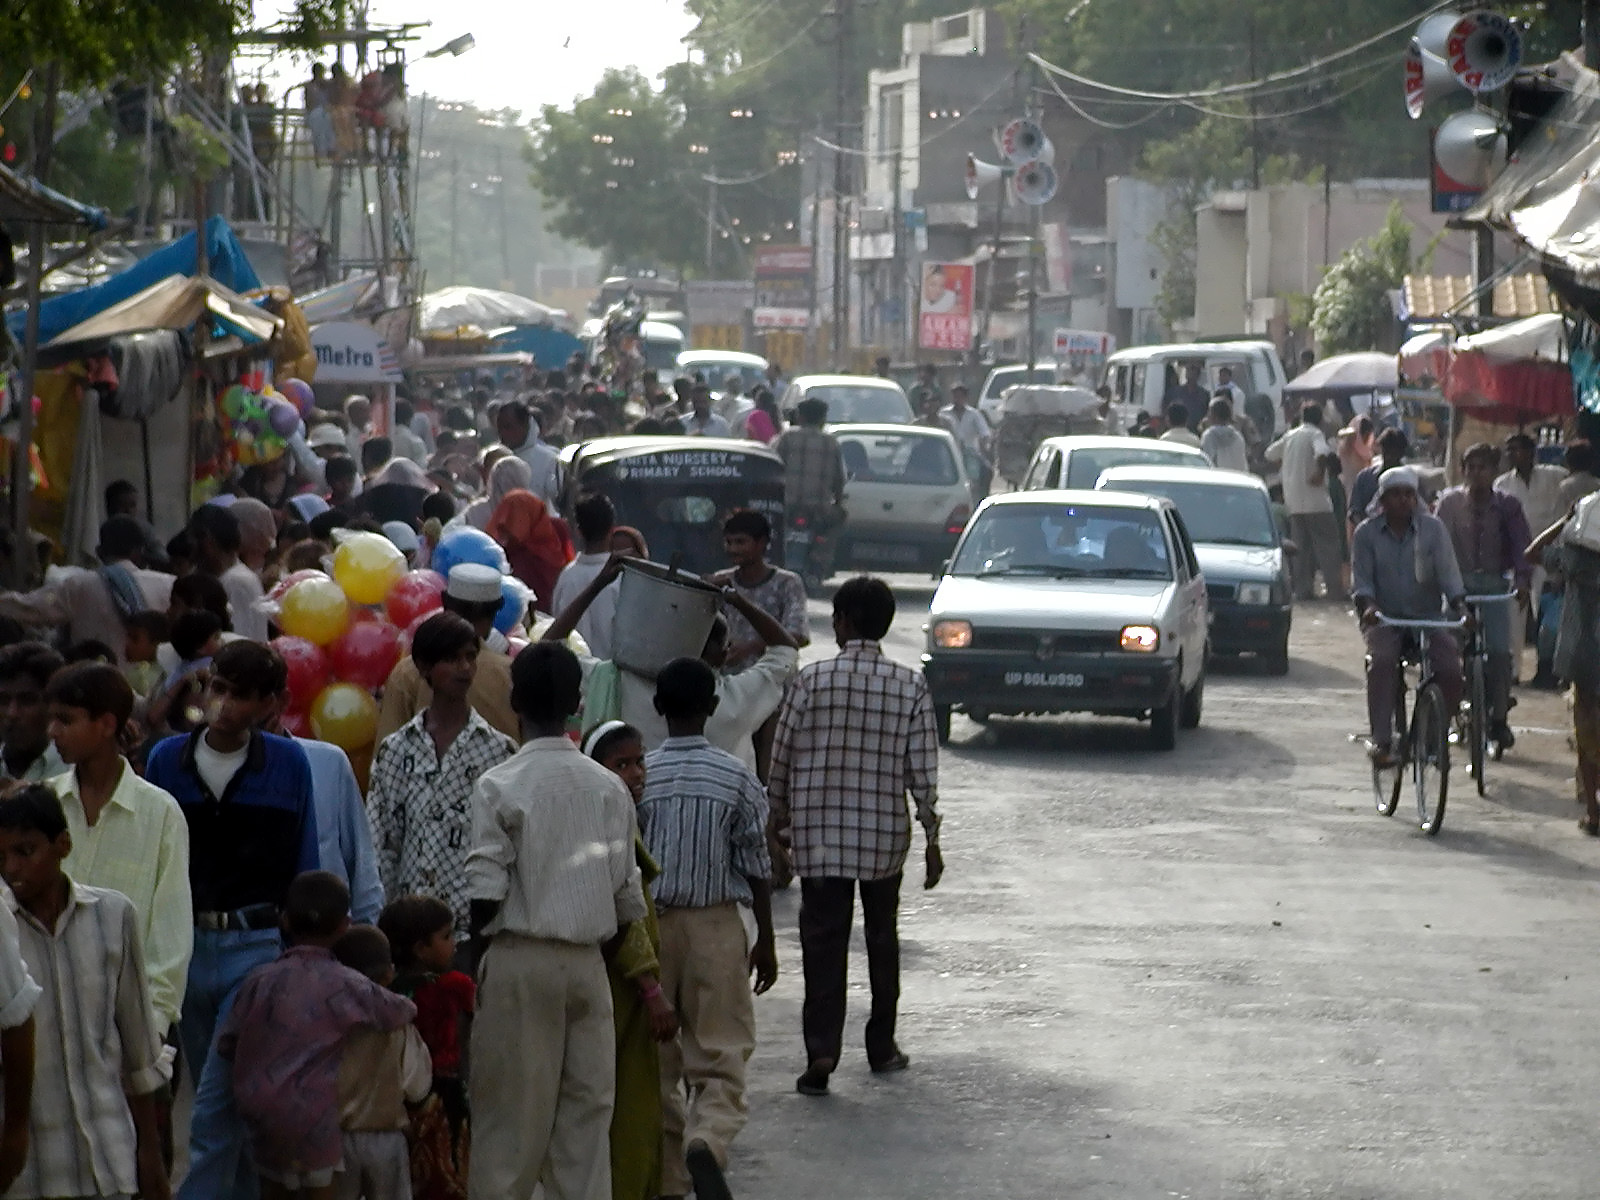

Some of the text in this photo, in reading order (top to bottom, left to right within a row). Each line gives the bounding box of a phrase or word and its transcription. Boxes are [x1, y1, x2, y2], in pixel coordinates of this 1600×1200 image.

[315, 344, 374, 366] Metro
[662, 452, 728, 466] NURSERY
[690, 466, 742, 478] SCHOOL
